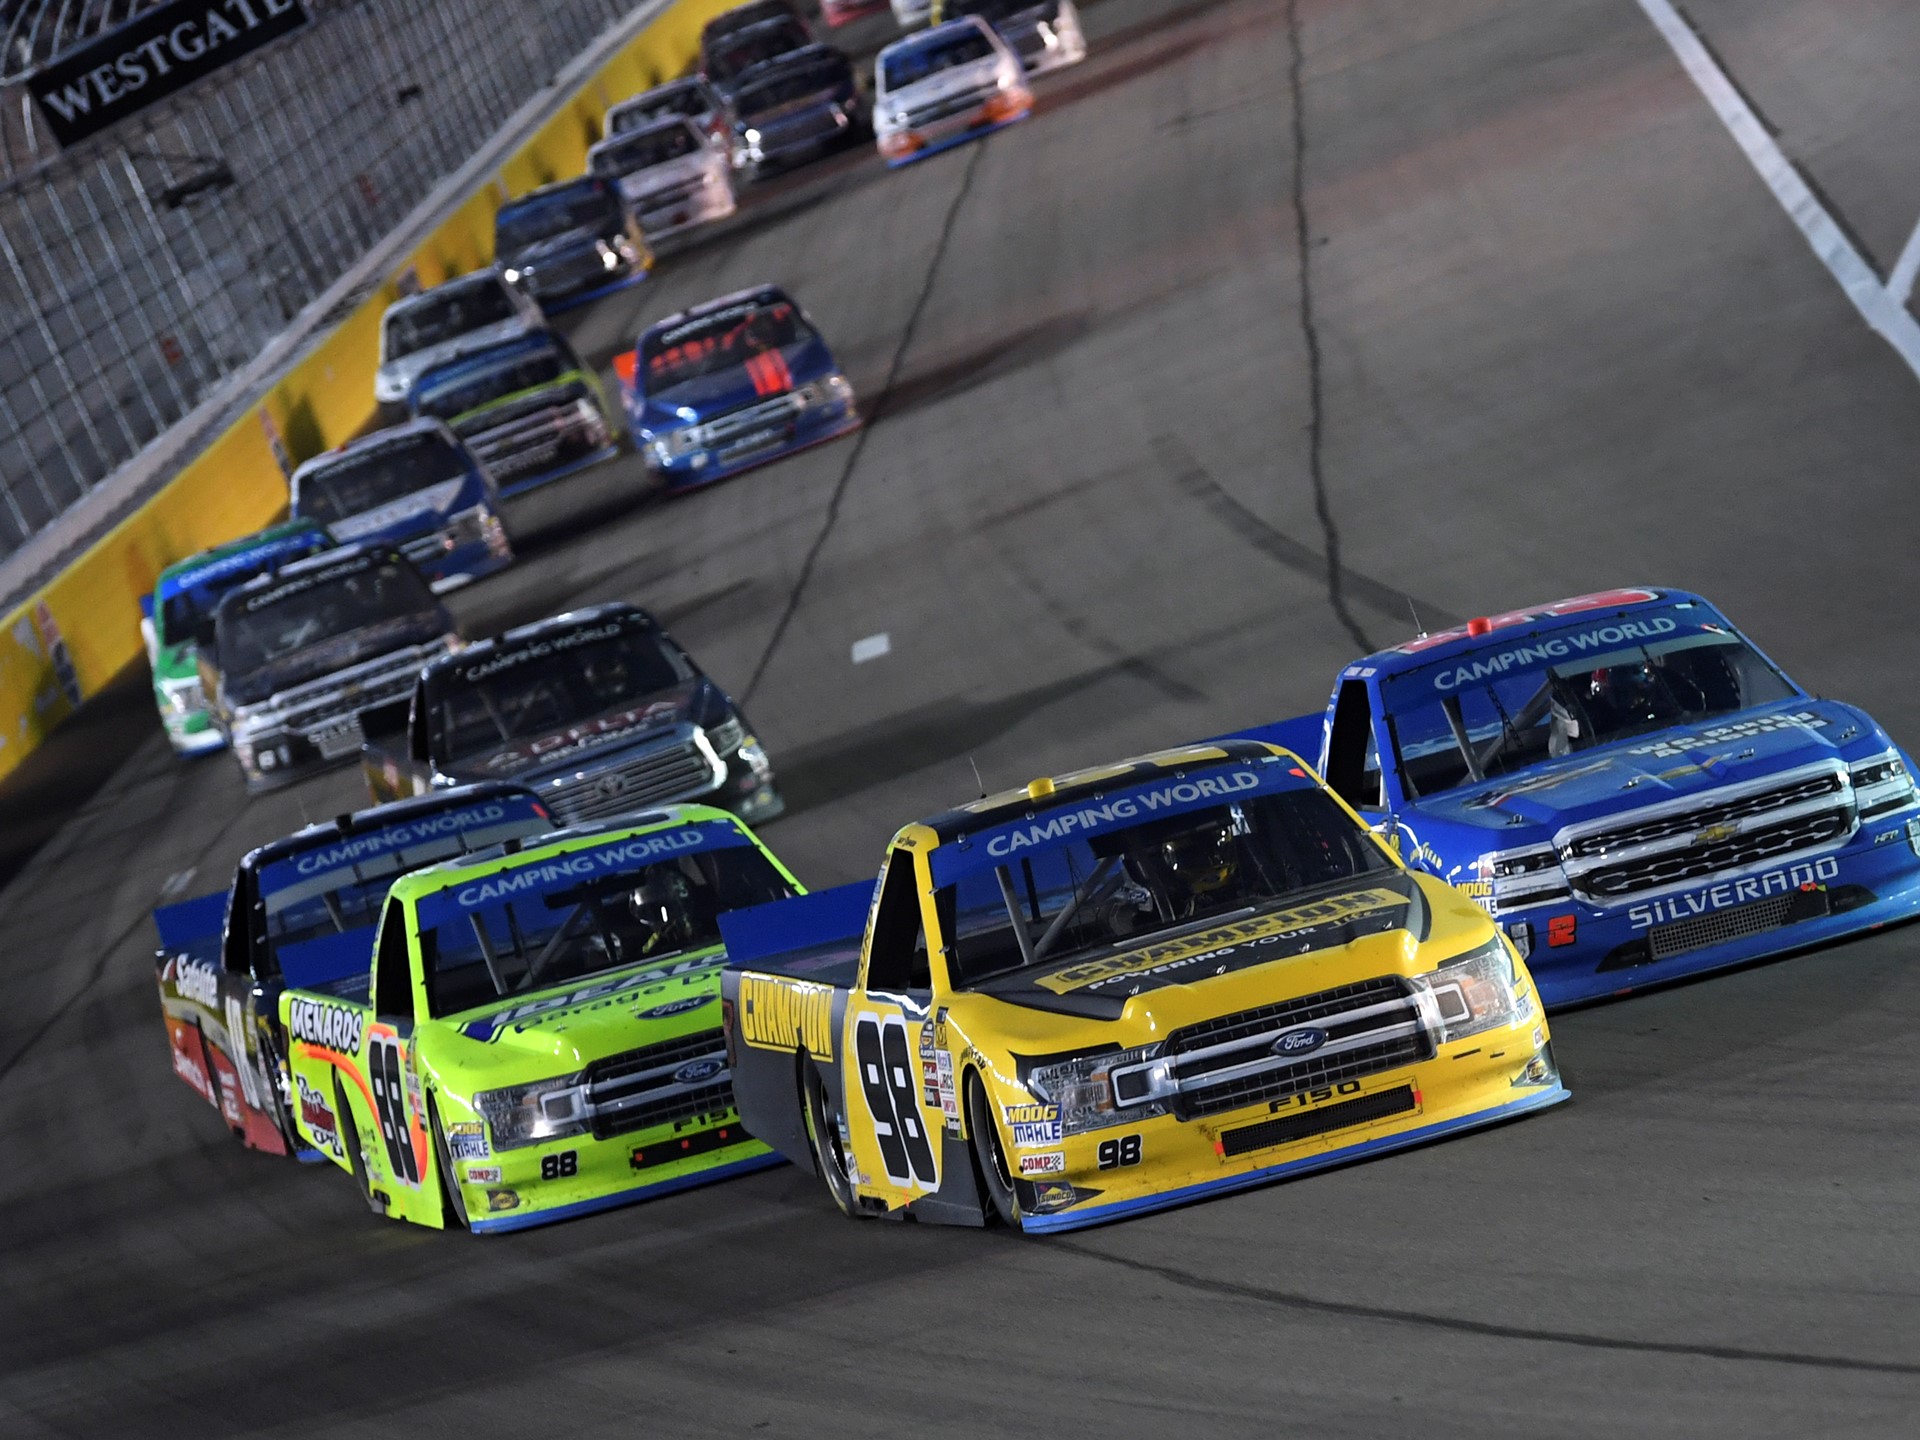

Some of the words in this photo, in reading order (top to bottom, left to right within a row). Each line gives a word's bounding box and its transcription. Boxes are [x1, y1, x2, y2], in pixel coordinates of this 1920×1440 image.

[466, 641, 551, 682] CAMPING
[553, 622, 622, 651] WORLD
[1433, 638, 1569, 691] CAMPING
[1568, 616, 1676, 651] WORLD
[986, 799, 1138, 857] CAMPING
[1137, 771, 1259, 811] WORLD
[296, 826, 410, 875] CAMPING
[413, 804, 504, 838] WORLD
[458, 856, 594, 906] CAMPING
[596, 829, 703, 867] WORLD
[1628, 855, 1840, 931] SILVERADO
[1057, 892, 1380, 982] CHAMPION
[1088, 947, 1236, 990] POWERING
[1241, 926, 1317, 949] YOUR
[682, 970, 721, 986] D
[652, 998, 702, 1017] Ford
[740, 976, 833, 1059] CHAMPION
[290, 998, 364, 1057] MENARDS
[1284, 1032, 1314, 1050] Ford
[684, 1060, 713, 1080] Ford
[368, 1034, 421, 1190] 88
[855, 1012, 940, 1193] 98
[1008, 1105, 1058, 1124] MOOG
[1268, 1080, 1361, 1114] F150
[674, 1106, 740, 1133] F15
[1014, 1123, 1061, 1143] MAHLE
[541, 1150, 577, 1180] 88
[1022, 1155, 1051, 1171] COMP
[1098, 1134, 1142, 1171] 98
[469, 1168, 490, 1181] COMP
[1040, 1190, 1075, 1203] SUNOCO
